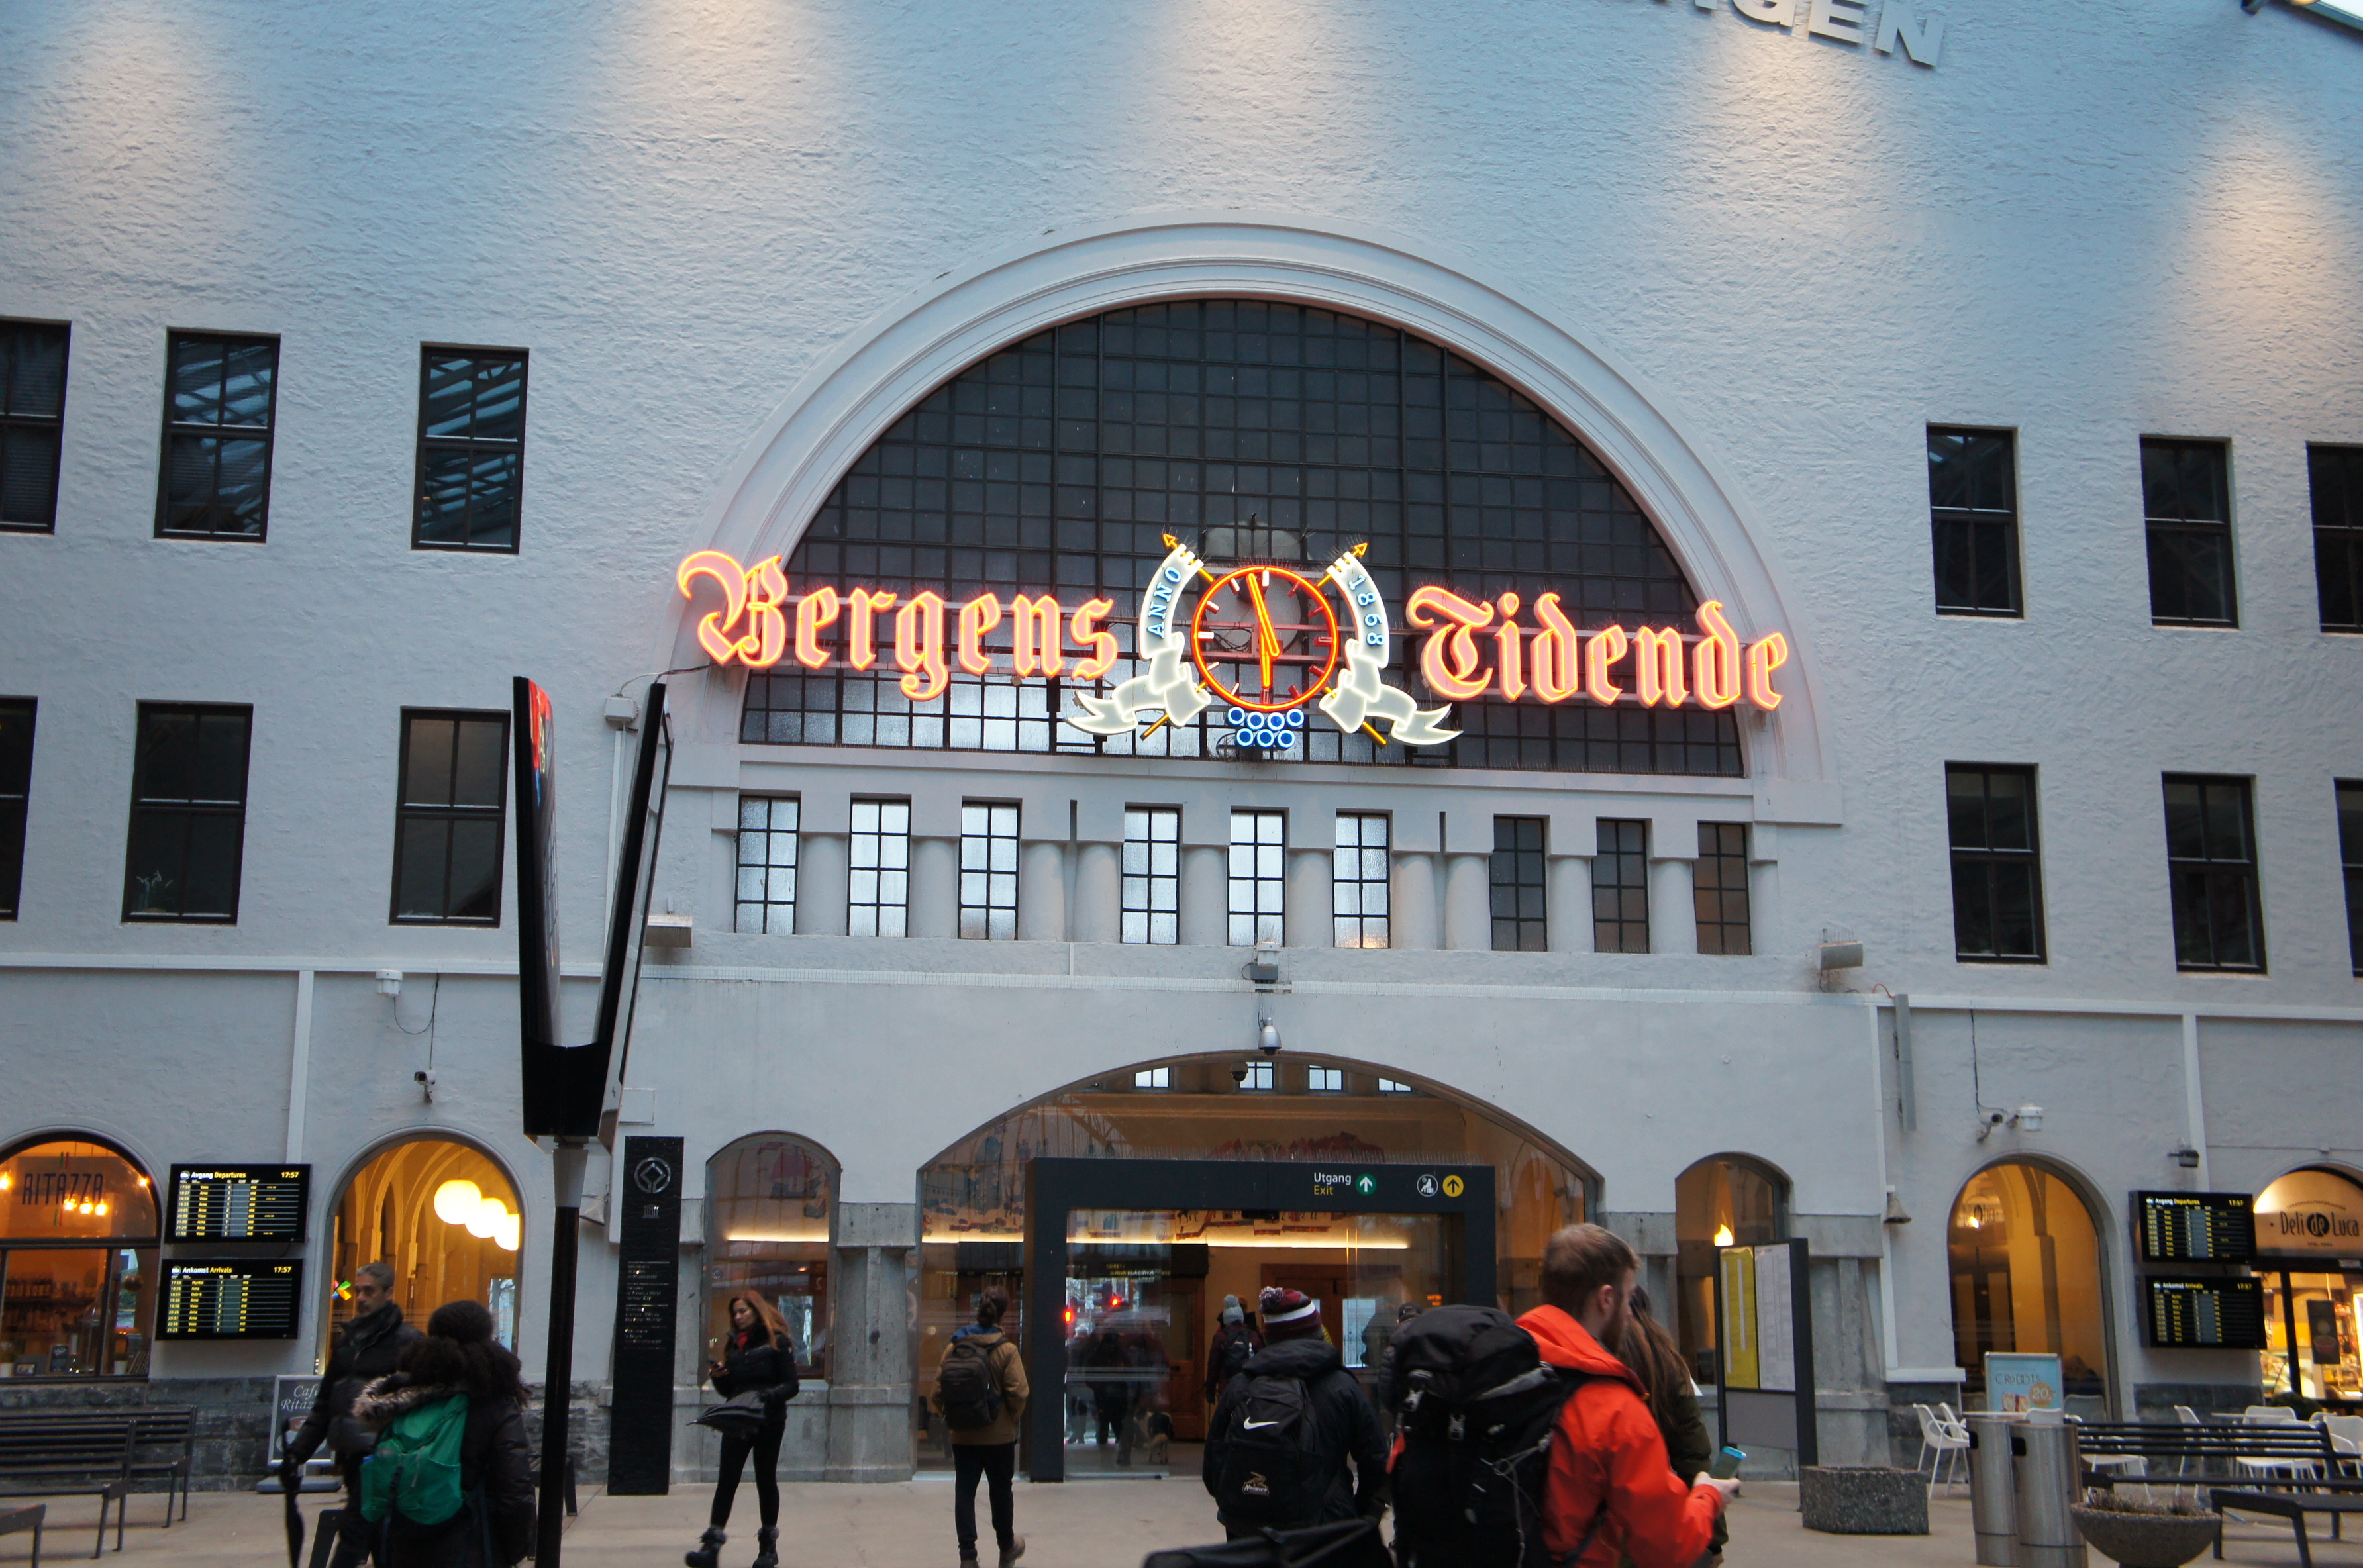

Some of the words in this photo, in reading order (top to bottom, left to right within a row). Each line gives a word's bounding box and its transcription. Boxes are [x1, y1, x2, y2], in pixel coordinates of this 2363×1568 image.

[1147, 567, 1182, 639] ANNO
[1348, 575, 1385, 646] 1868
[676, 549, 1119, 702] Bergens
[1406, 585, 1787, 711] Tidende
[1314, 1173, 1352, 1185] Utgang
[1314, 1185, 1333, 1195] Exit
[2280, 1212, 2305, 1235] Deli
[2331, 1212, 2360, 1236] Luca
[281, 1398, 315, 1412] Ritaz
